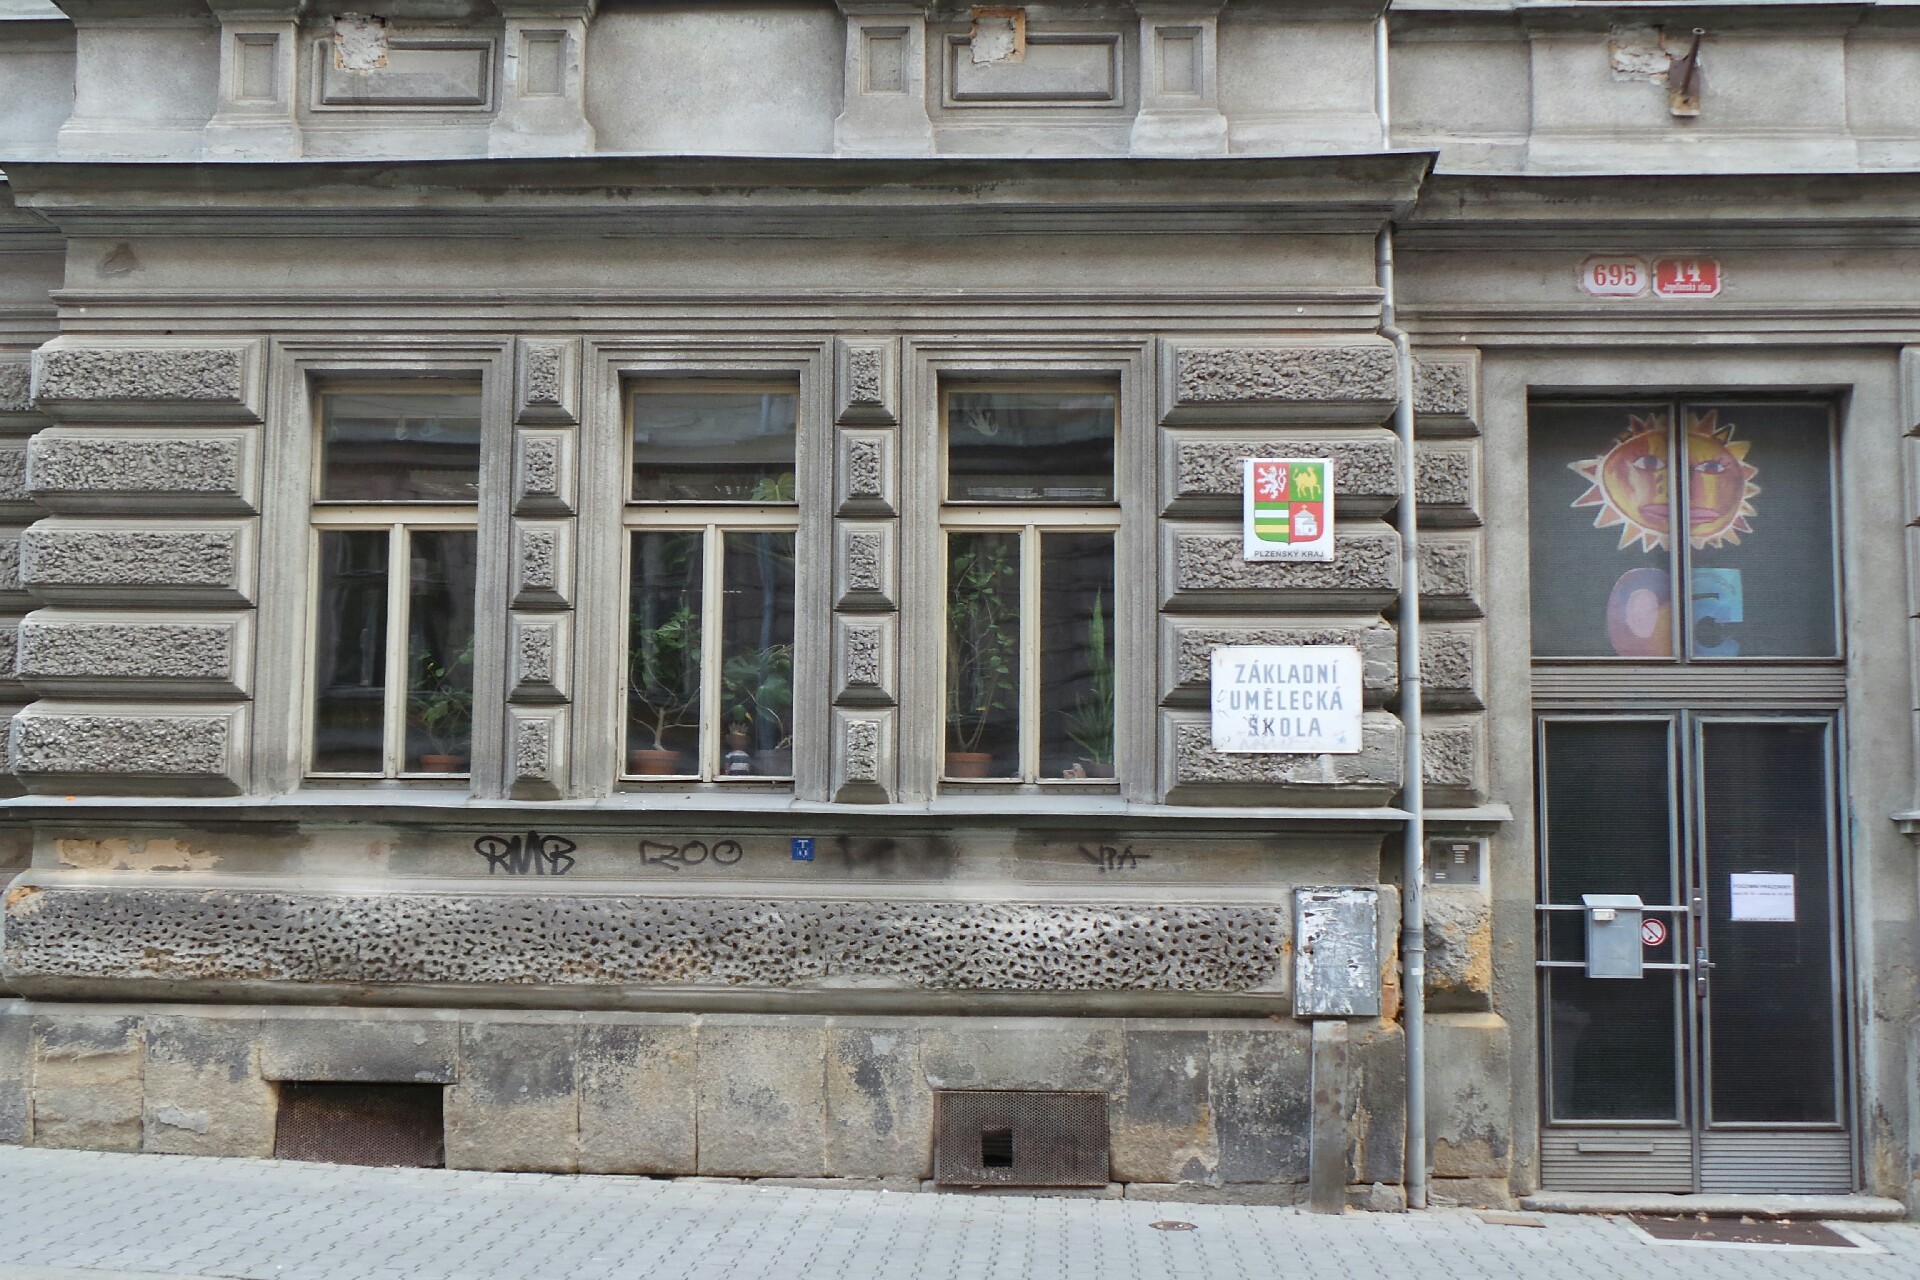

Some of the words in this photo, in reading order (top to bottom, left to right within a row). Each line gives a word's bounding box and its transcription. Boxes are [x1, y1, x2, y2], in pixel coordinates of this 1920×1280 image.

[1593, 263, 1637, 286] 695
[1674, 260, 1701, 282] 14
[1301, 550, 1324, 558] KRAJ
[1234, 659, 1339, 684] ZÁKLADNÍ
[1229, 686, 1343, 711] UMĚLECKÁ
[1247, 713, 1323, 738] ŠKOLA
